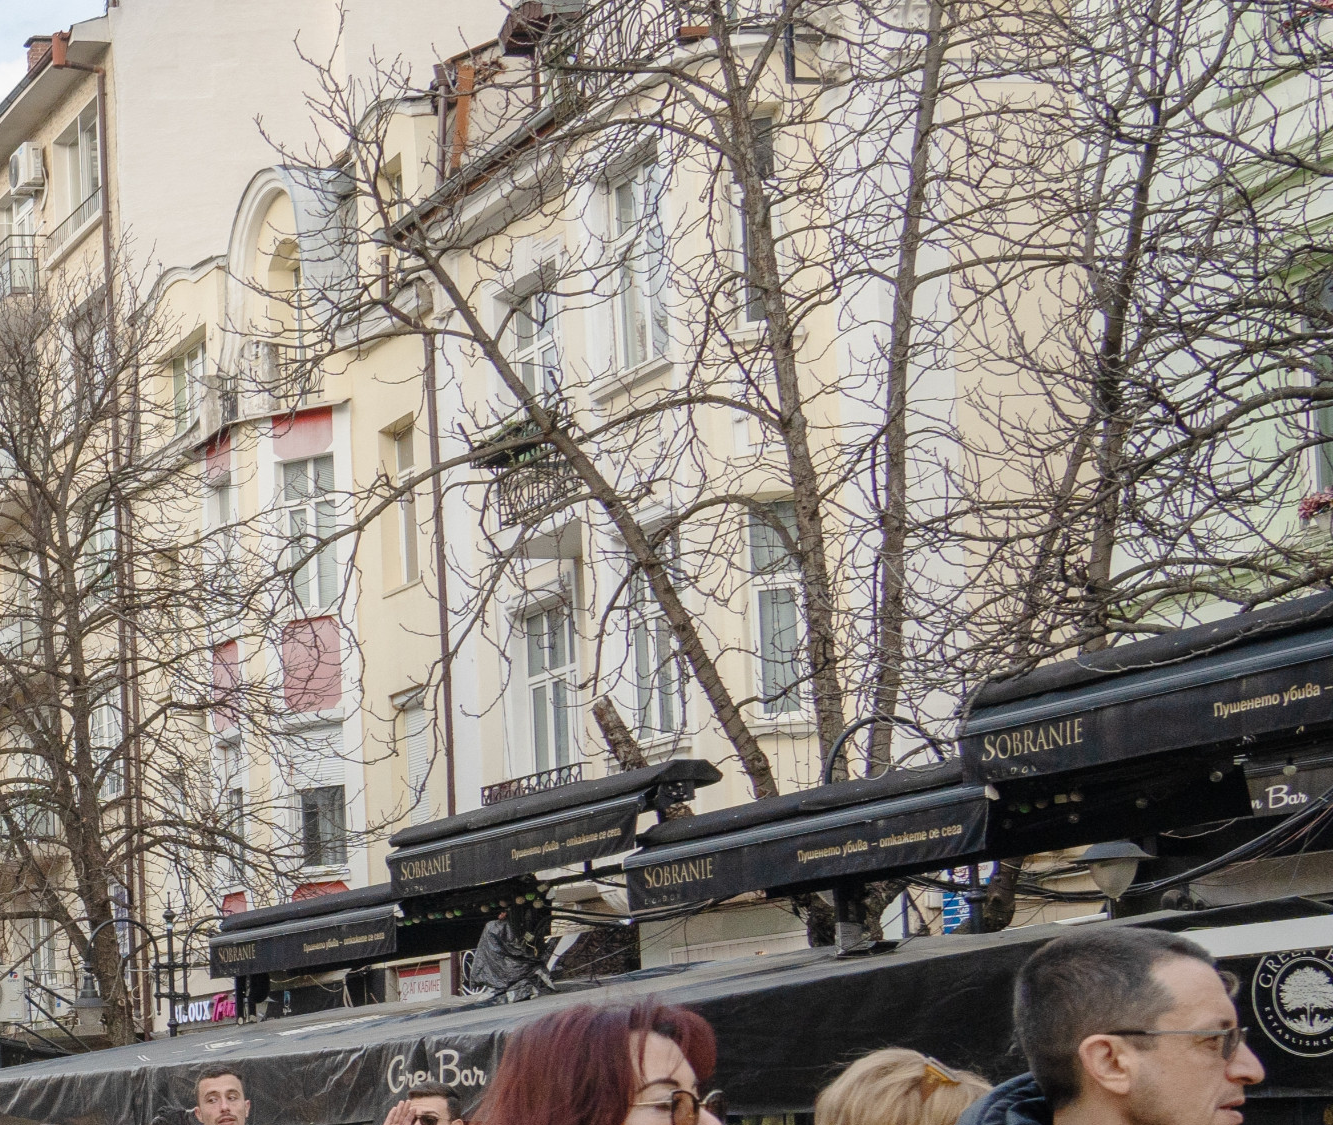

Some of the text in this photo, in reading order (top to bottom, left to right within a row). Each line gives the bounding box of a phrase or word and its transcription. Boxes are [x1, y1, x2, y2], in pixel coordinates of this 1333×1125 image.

[1213, 692, 1280, 720] Пушенето
[1282, 682, 1321, 707] убива
[981, 718, 1084, 762] SOBRANIE
[1265, 784, 1308, 809] Bar
[797, 847, 840, 864] Пушенето
[842, 839, 868, 858] убива
[879, 831, 927, 848] откажете
[928, 828, 940, 840] се
[941, 823, 962, 837] сега
[400, 853, 451, 881] SOBRANIE
[643, 857, 713, 889] SOBRANIE
[218, 943, 255, 963] SOBRANIE
[434, 1049, 487, 1088] Bar
